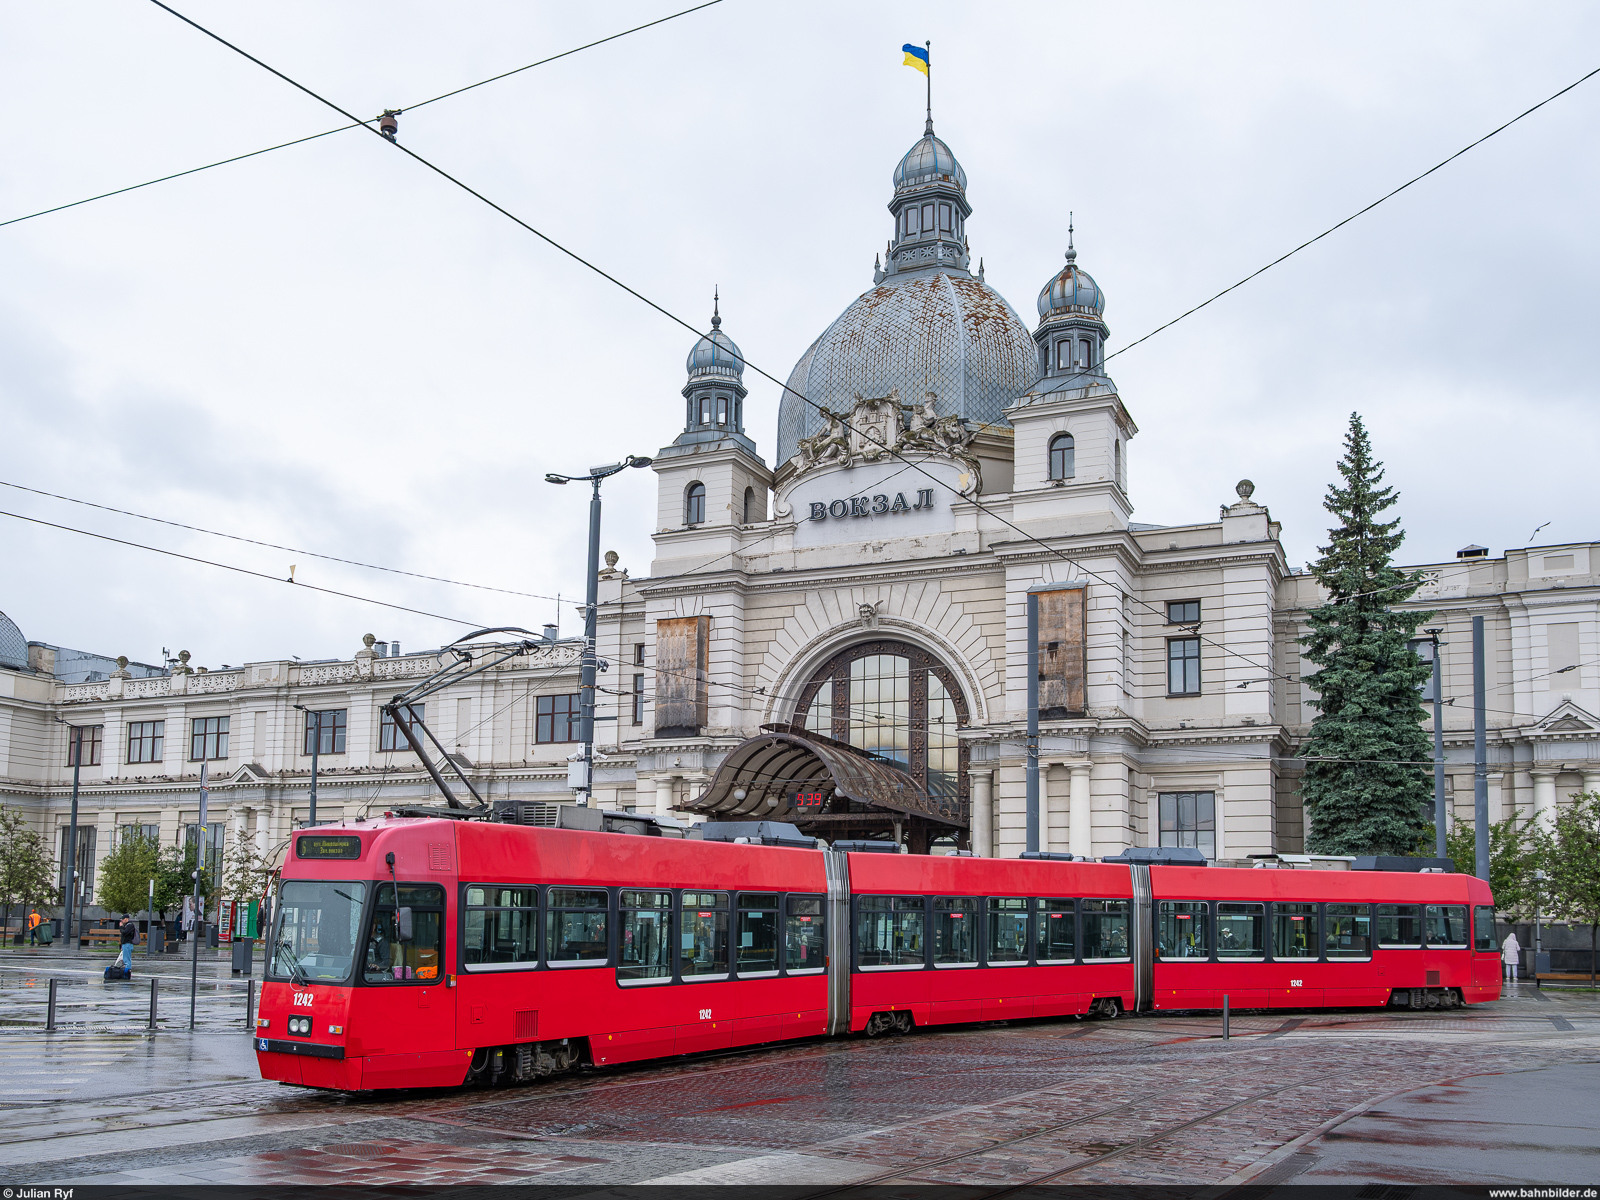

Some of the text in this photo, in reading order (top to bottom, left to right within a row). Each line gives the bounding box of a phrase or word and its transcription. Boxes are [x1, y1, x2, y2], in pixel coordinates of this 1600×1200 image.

[809, 487, 934, 521] ВОКЗАЛ
[1290, 979, 1303, 987] 1242
[293, 992, 314, 1007] 1242
[699, 1008, 712, 1020] 1242
